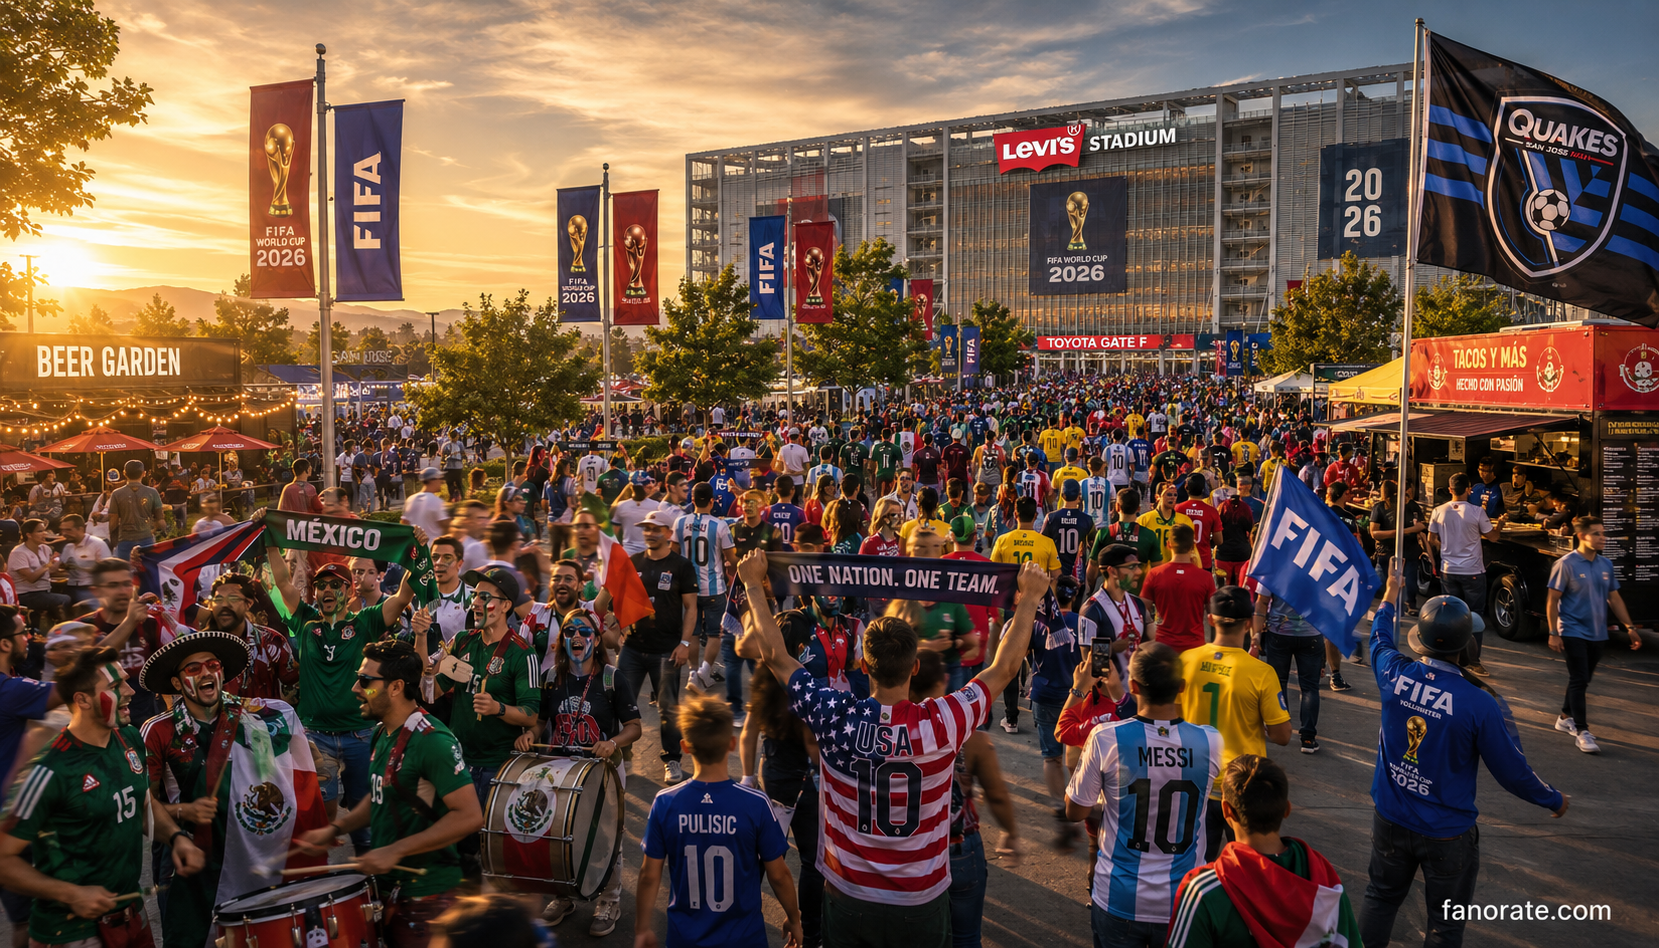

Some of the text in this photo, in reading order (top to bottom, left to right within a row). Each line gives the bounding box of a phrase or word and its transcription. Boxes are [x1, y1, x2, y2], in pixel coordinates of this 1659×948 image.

[1089, 128, 1176, 151] STADIUM
[1508, 108, 1619, 158] QUAKES
[1345, 168, 1383, 202] 20
[353, 151, 382, 249] FIFA
[265, 226, 295, 237] FIFA
[1343, 205, 1382, 238] 26
[256, 237, 306, 247] WORLD CUP
[256, 249, 306, 267] 2026
[759, 242, 775, 294] FIFA
[1047, 255, 1108, 265] FIFA WORLD CUP
[1049, 265, 1105, 283] 2026
[562, 292, 595, 304] 2026
[966, 338, 976, 364] FIFA
[1046, 337, 1148, 349] TOYOTA GATE F
[1453, 340, 1527, 369] TACOS Y MÁS
[36, 345, 181, 378] BEER GARDEN
[1456, 374, 1524, 392] HECHO CON PASIÓN
[1112, 454, 1124, 470] 10
[1089, 491, 1104, 510] 10
[286, 518, 381, 551] MÉXICO
[1058, 528, 1079, 554] 10
[683, 535, 709, 566] 10
[1271, 507, 1360, 617] FIFA
[788, 564, 1000, 595] ONE NATION. ONE TEAM.
[1394, 674, 1454, 716] FIFA
[855, 721, 914, 758] USA
[1138, 746, 1193, 768] MESSI
[1390, 768, 1430, 796] 2026
[113, 785, 137, 824] 15
[850, 758, 923, 838] 10
[678, 813, 737, 836] PULISIC
[1126, 778, 1200, 854] 10
[684, 845, 735, 913] 10
